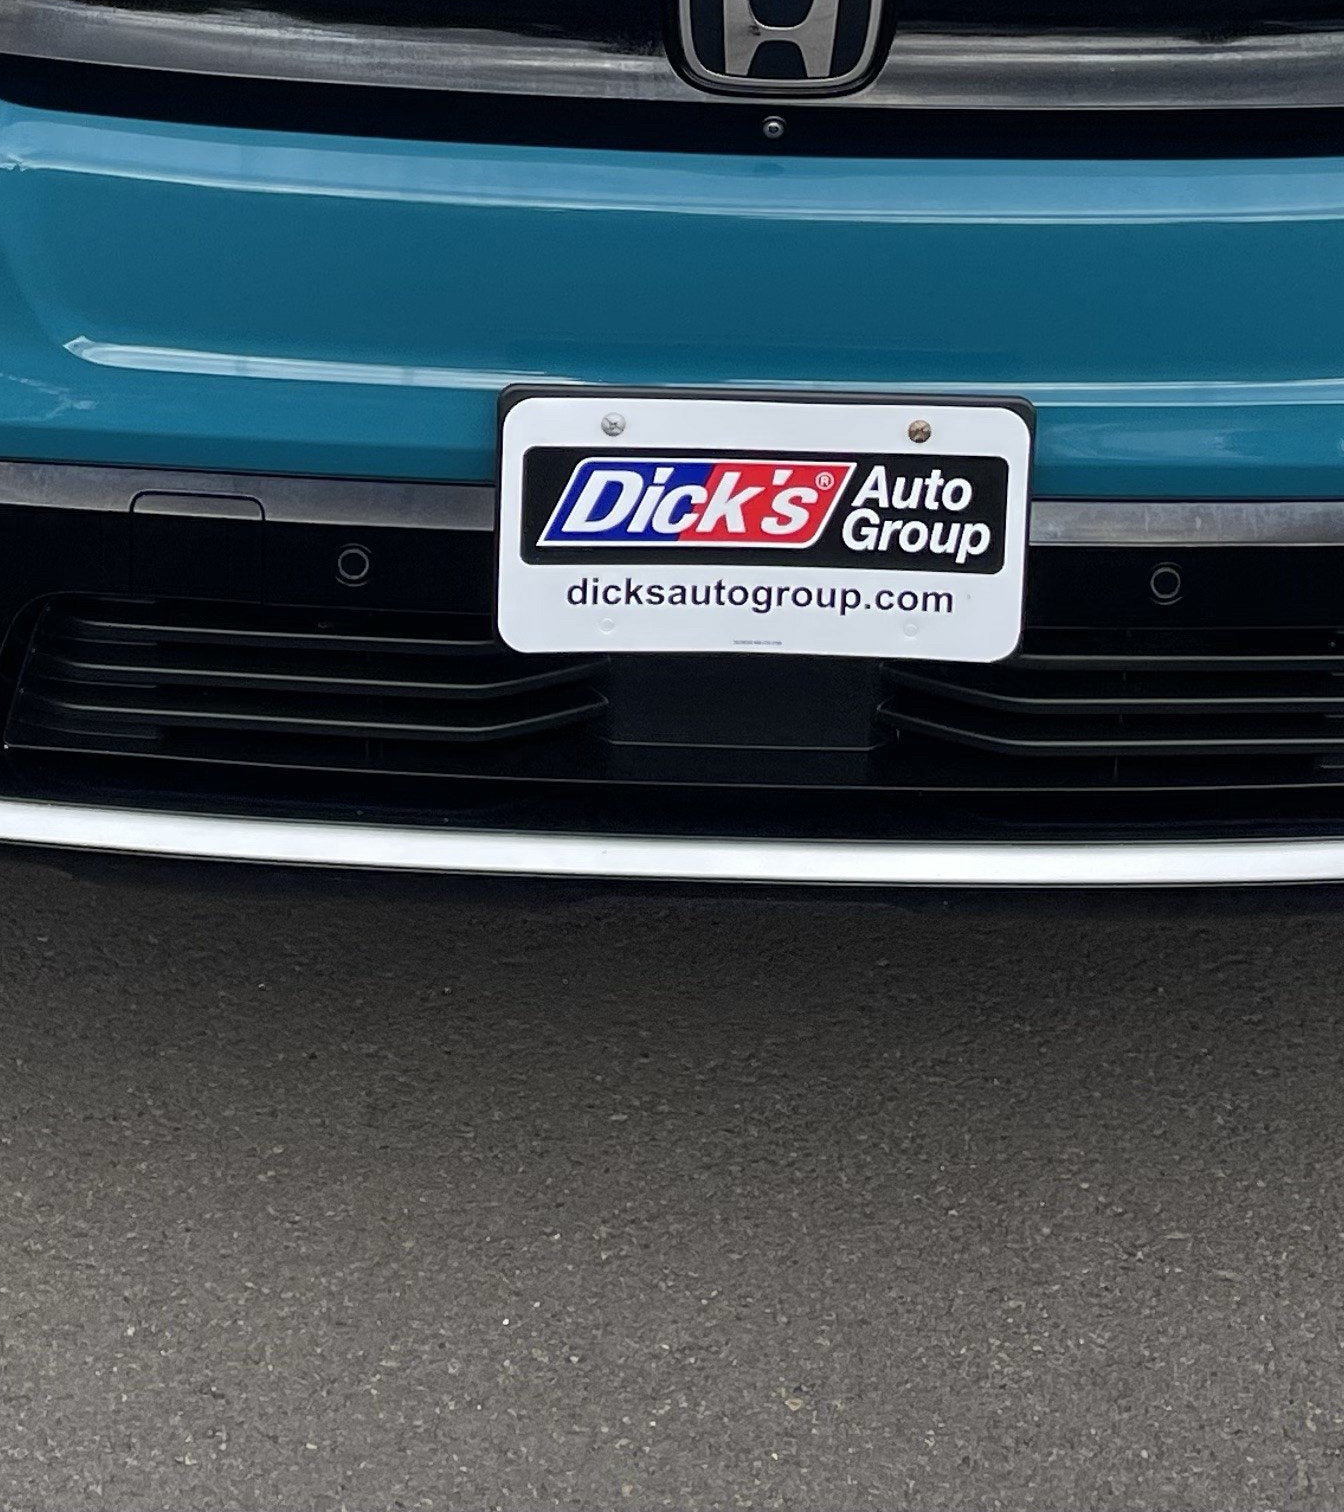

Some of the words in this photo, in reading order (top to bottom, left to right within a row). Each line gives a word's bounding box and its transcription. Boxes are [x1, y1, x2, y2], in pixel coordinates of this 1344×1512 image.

[851, 465, 973, 512] Auto
[842, 508, 991, 564] Group
[567, 577, 954, 616] dicksautogroup.com
